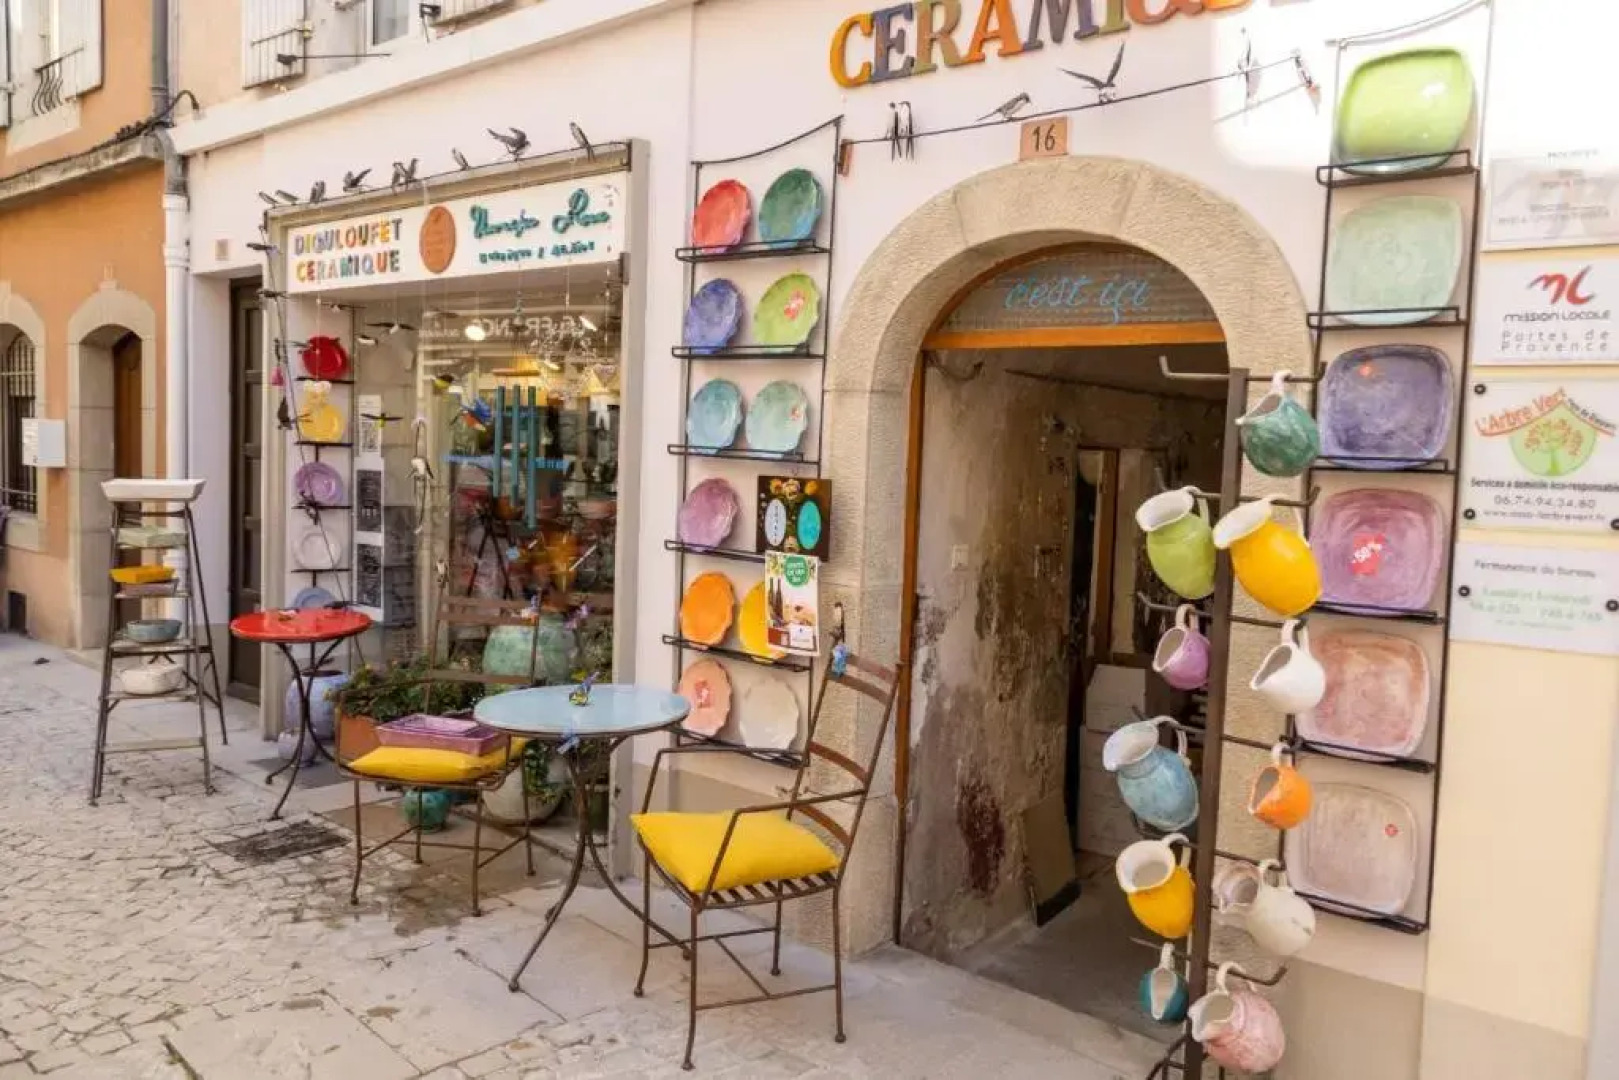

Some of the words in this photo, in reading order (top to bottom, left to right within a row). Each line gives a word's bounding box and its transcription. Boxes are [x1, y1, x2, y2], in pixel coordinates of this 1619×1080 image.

[1032, 124, 1055, 152] 16
[296, 249, 400, 283] CERAMIQUE
[1584, 328, 1609, 341] de
[1501, 341, 1608, 353] Provence
[1475, 405, 1533, 433] L'Arbre
[1471, 476, 1505, 489] Services
